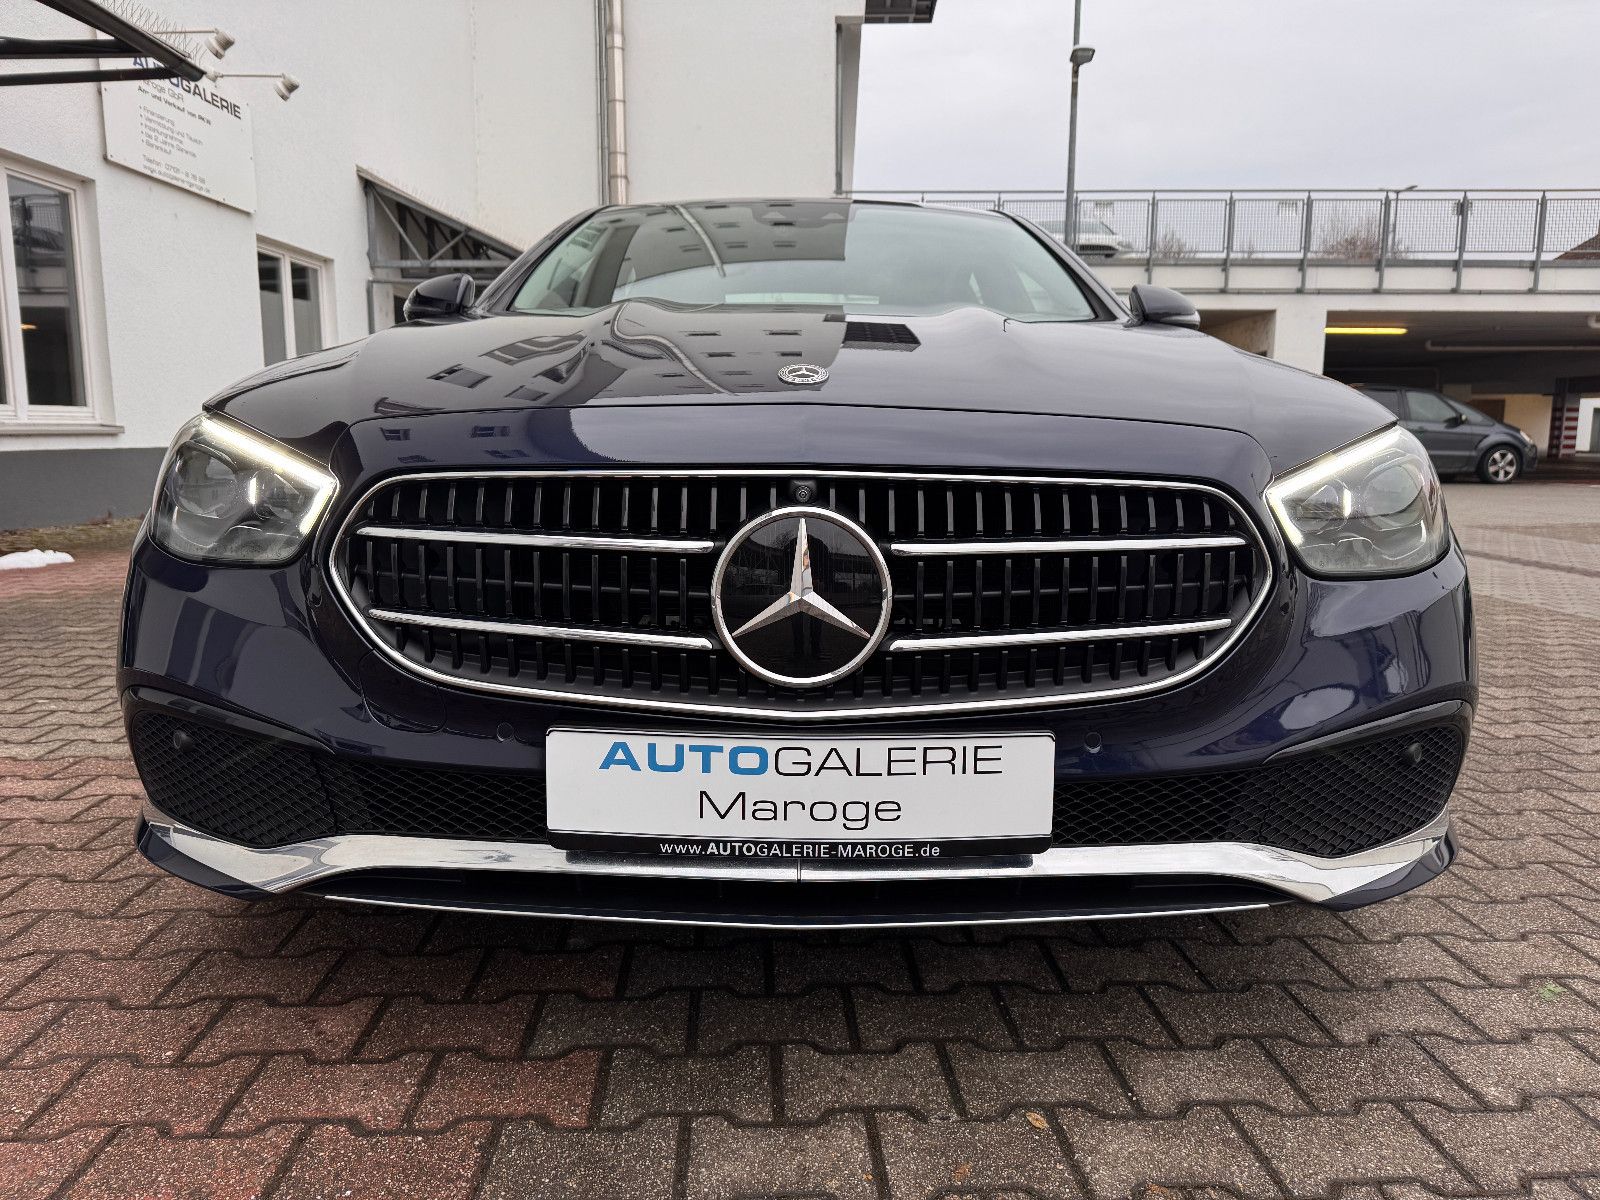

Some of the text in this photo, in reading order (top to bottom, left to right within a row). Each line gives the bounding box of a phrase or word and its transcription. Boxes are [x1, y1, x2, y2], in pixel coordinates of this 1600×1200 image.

[599, 741, 1003, 777] AUTOGALERIE
[699, 790, 902, 831] Maroge
[659, 842, 941, 859] www.AUTOGALERIE-MAROGE.de
